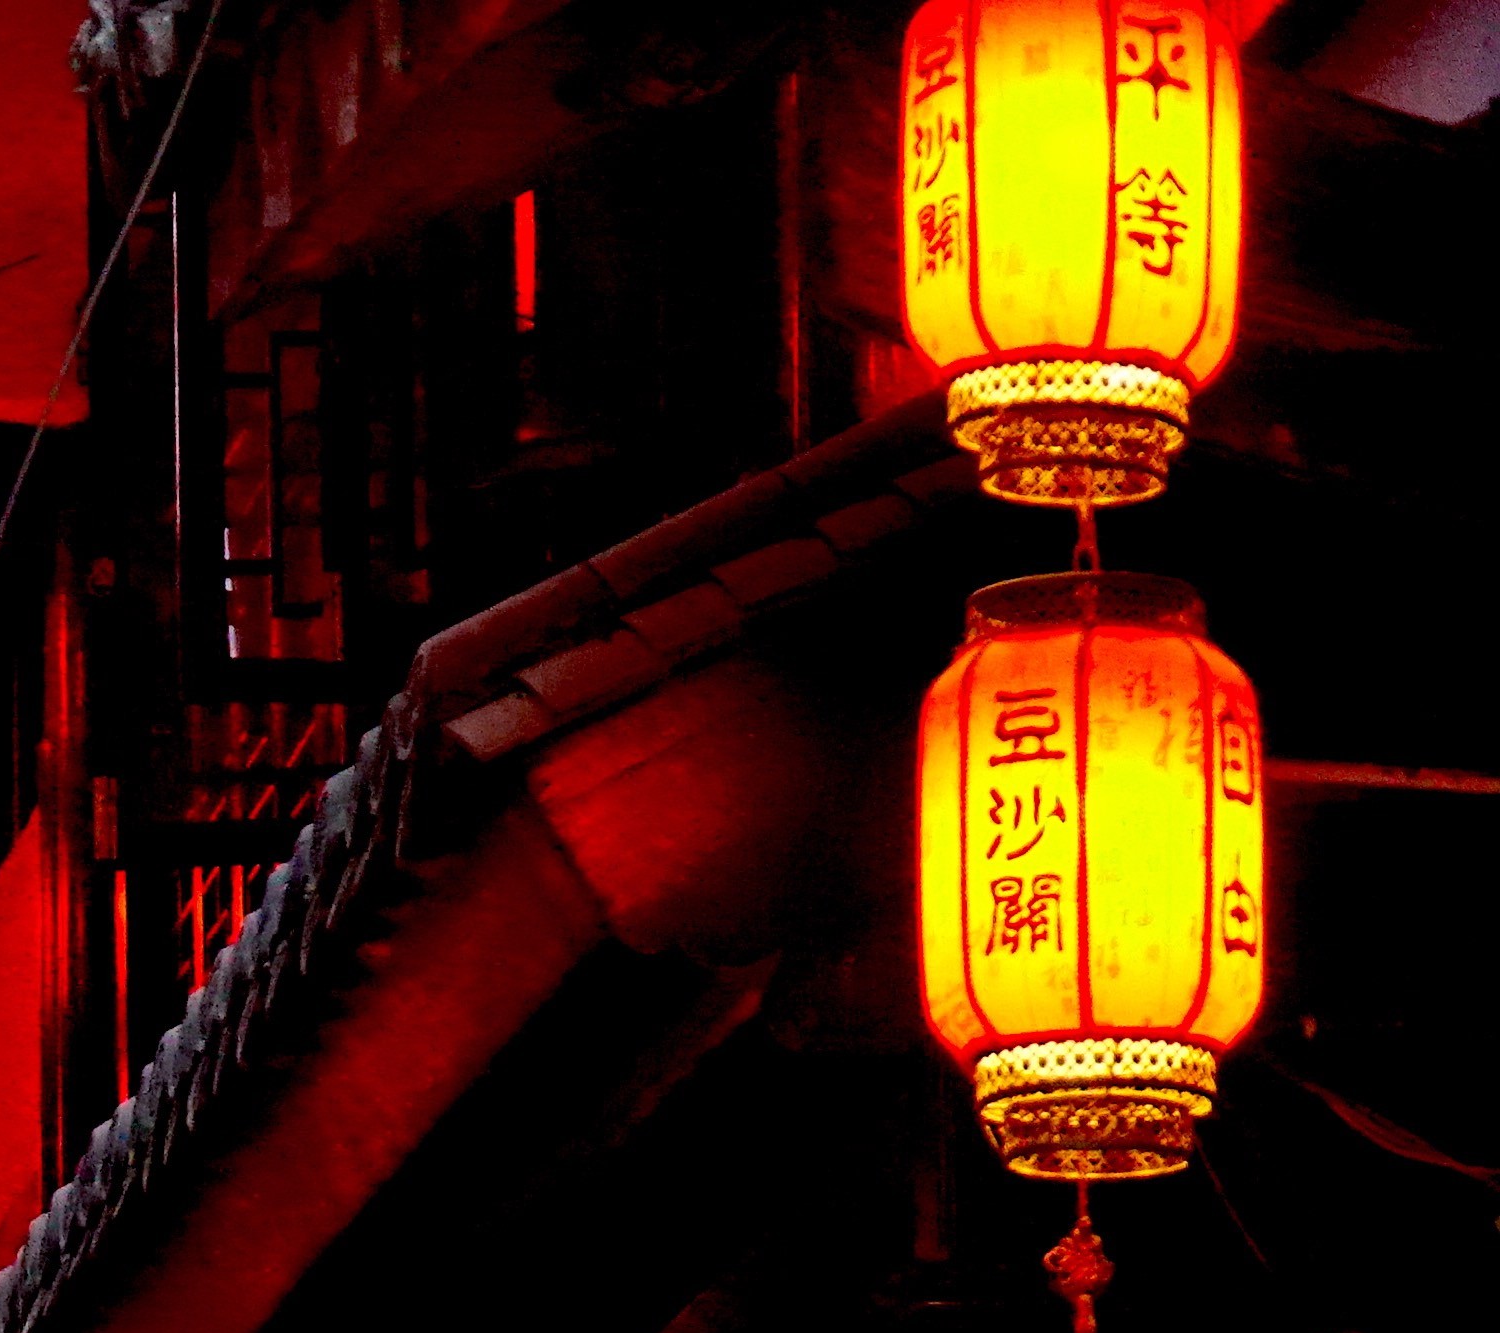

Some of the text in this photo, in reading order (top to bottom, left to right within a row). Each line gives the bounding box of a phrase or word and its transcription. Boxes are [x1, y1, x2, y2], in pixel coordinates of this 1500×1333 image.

[911, 40, 964, 287] 豆沙關
[1116, 20, 1192, 276] 平等
[986, 690, 1066, 957] 豆沙關
